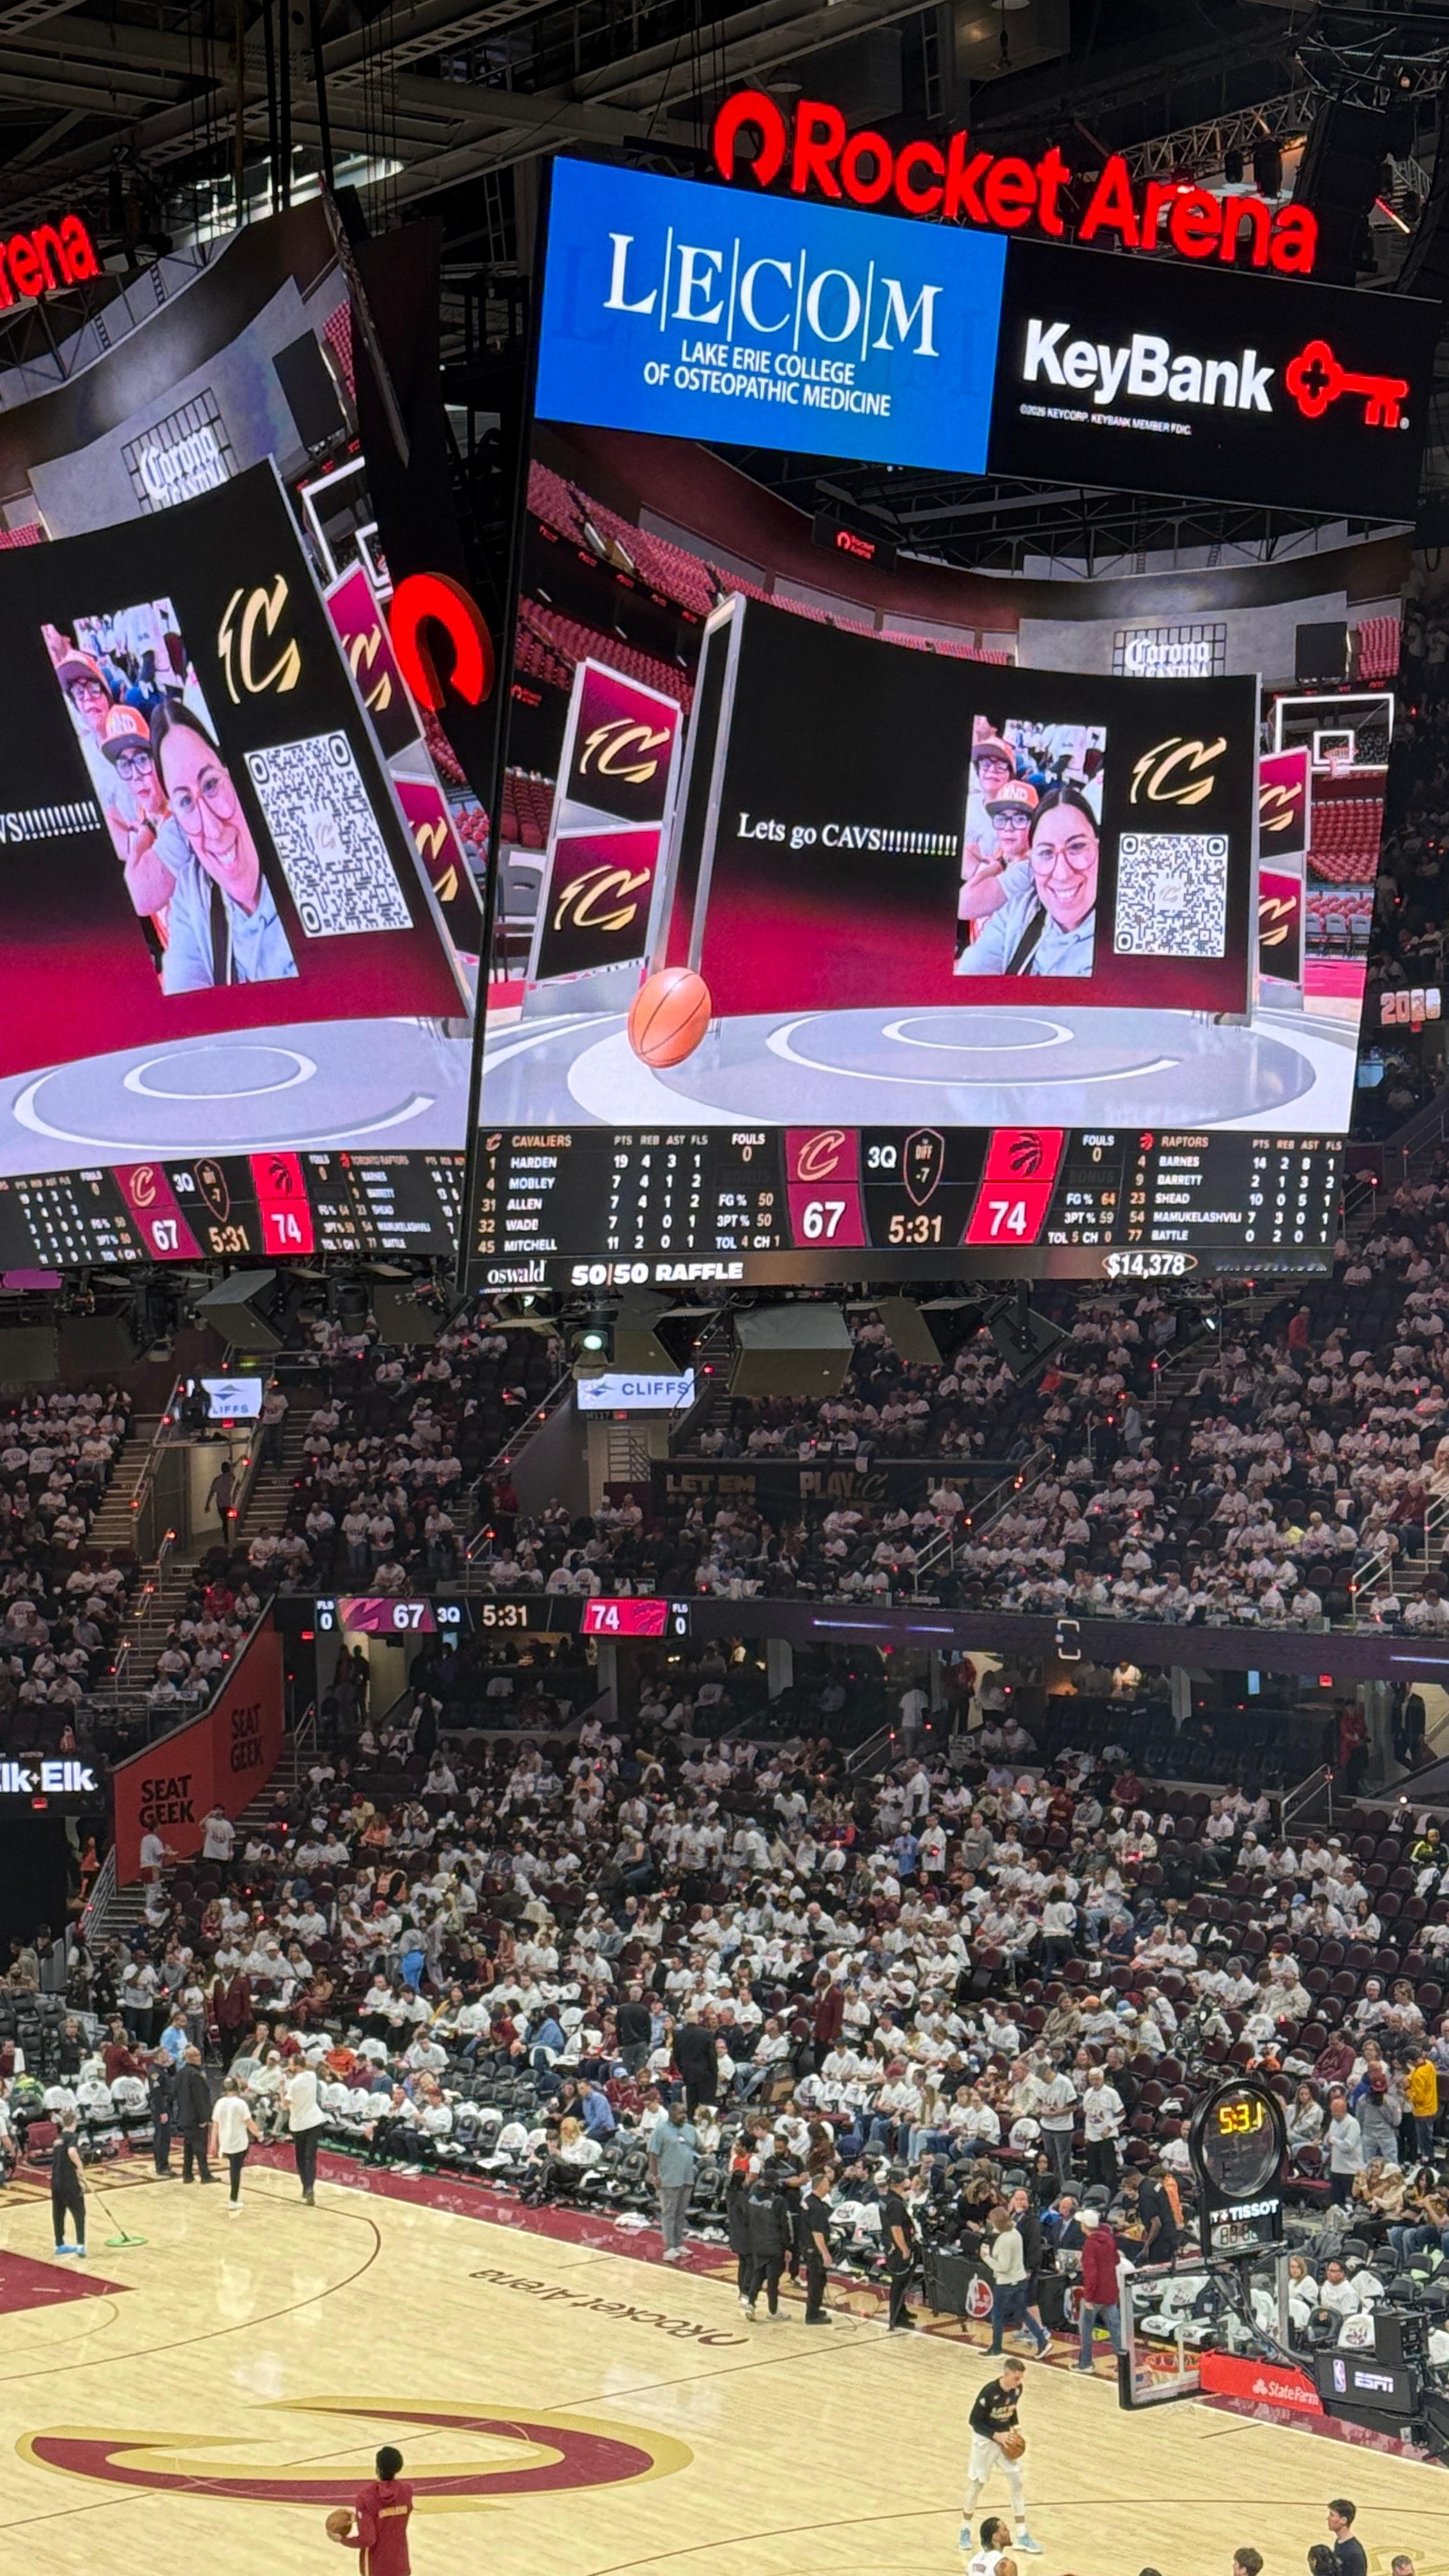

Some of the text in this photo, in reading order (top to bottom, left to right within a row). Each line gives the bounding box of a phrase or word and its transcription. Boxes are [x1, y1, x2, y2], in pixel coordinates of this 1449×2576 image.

[792, 99, 1318, 273] Rocket Arena
[682, 339, 855, 386] LAKE ERIE COLLEGE
[1023, 319, 1275, 412] KeyBank
[643, 362, 891, 417] OF OSTEOPATHIC MEDICINE
[1091, 413, 1131, 427] KEYBANK
[1132, 419, 1170, 432] MEMBER
[1125, 638, 1210, 671] Corona
[737, 812, 785, 842] Lets
[789, 826, 817, 849] go
[512, 1135, 572, 1147] CAVALIERS
[614, 1135, 632, 1146] PTS
[666, 1135, 686, 1145] AST
[691, 1135, 709, 1145] FLS
[732, 1133, 766, 1145] FOULS
[1082, 1135, 1115, 1147] FOULS
[1161, 1135, 1342, 1151] RAPTORS PTS REB AST FLS
[489, 1154, 700, 1170] 1 HARDEN 19 4 3 1
[742, 1146, 753, 1162] 0
[868, 1146, 897, 1169] 3Q
[1092, 1147, 1101, 1162] 0
[1137, 1155, 1146, 1168] 4
[1159, 1156, 1200, 1167] BARNES
[1253, 1156, 1267, 1170] 14
[1280, 1156, 1289, 1170] 2
[1328, 1158, 1335, 1171] 1
[172, 1173, 195, 1192] 3Q
[486, 1178, 494, 1191] 4
[509, 1177, 555, 1190] MOBLEY
[612, 1175, 621, 1189] 7
[640, 1174, 649, 1188] 4
[666, 1174, 673, 1188] 1
[691, 1174, 702, 1188] 2
[916, 1168, 930, 1183] -7
[1135, 1174, 1335, 1189] 9 BARRETT 2 1 3 2
[482, 1194, 700, 1211] 31 ALLEN 7 4 1 2
[719, 1192, 774, 1207] FG % 50
[1066, 1192, 1116, 1206] FG % 64
[1130, 1192, 1330, 1208] 23 SHEAD 10 0 5 1
[479, 1214, 696, 1233] 32 WADE 7 1 0 1
[716, 1213, 772, 1227] 3PT % 50
[802, 1201, 845, 1239] 67
[988, 1201, 1027, 1236] 74
[1064, 1211, 1114, 1224] 3PT % 59
[1129, 1211, 1328, 1225] 54 MAMUKELASHVILI 7 3 0 1
[151, 1219, 179, 1251] 67
[271, 1213, 302, 1243] 74
[888, 1215, 942, 1243] 5:31
[1048, 1230, 1112, 1244] TOL 5 CH 0
[1128, 1229, 1326, 1243] 77 BATTLE 0 2 0 1
[208, 1225, 250, 1253] 5:31
[478, 1234, 694, 1254] 45 MITCHELL 11 2 0 1
[715, 1234, 780, 1250] TOL 4 CH 1
[487, 1260, 546, 1284] oswald
[656, 1262, 744, 1282] RAFFLE
[1107, 1254, 1185, 1279] $14,378
[622, 1382, 689, 1396] CLIFFS
[666, 1474, 756, 1493] LET EM
[800, 1471, 855, 1499] PLAY
[321, 1613, 332, 1630] 0
[393, 1605, 425, 1629] 67
[437, 1607, 461, 1623] 3Q
[482, 1605, 527, 1627] 5:31
[591, 1605, 620, 1630] 74
[675, 1618, 686, 1635] 0
[231, 1703, 261, 1741] SEAT
[231, 1735, 264, 1773] GEEK
[141, 1774, 192, 1803] SEAT
[139, 1800, 195, 1830] GEEK
[1220, 2102, 1264, 2133] 5:31
[1229, 2200, 1278, 2221] TISSOT
[468, 2269, 718, 2338] Rocket Arena
[1354, 2372, 1393, 2393] ESPN
